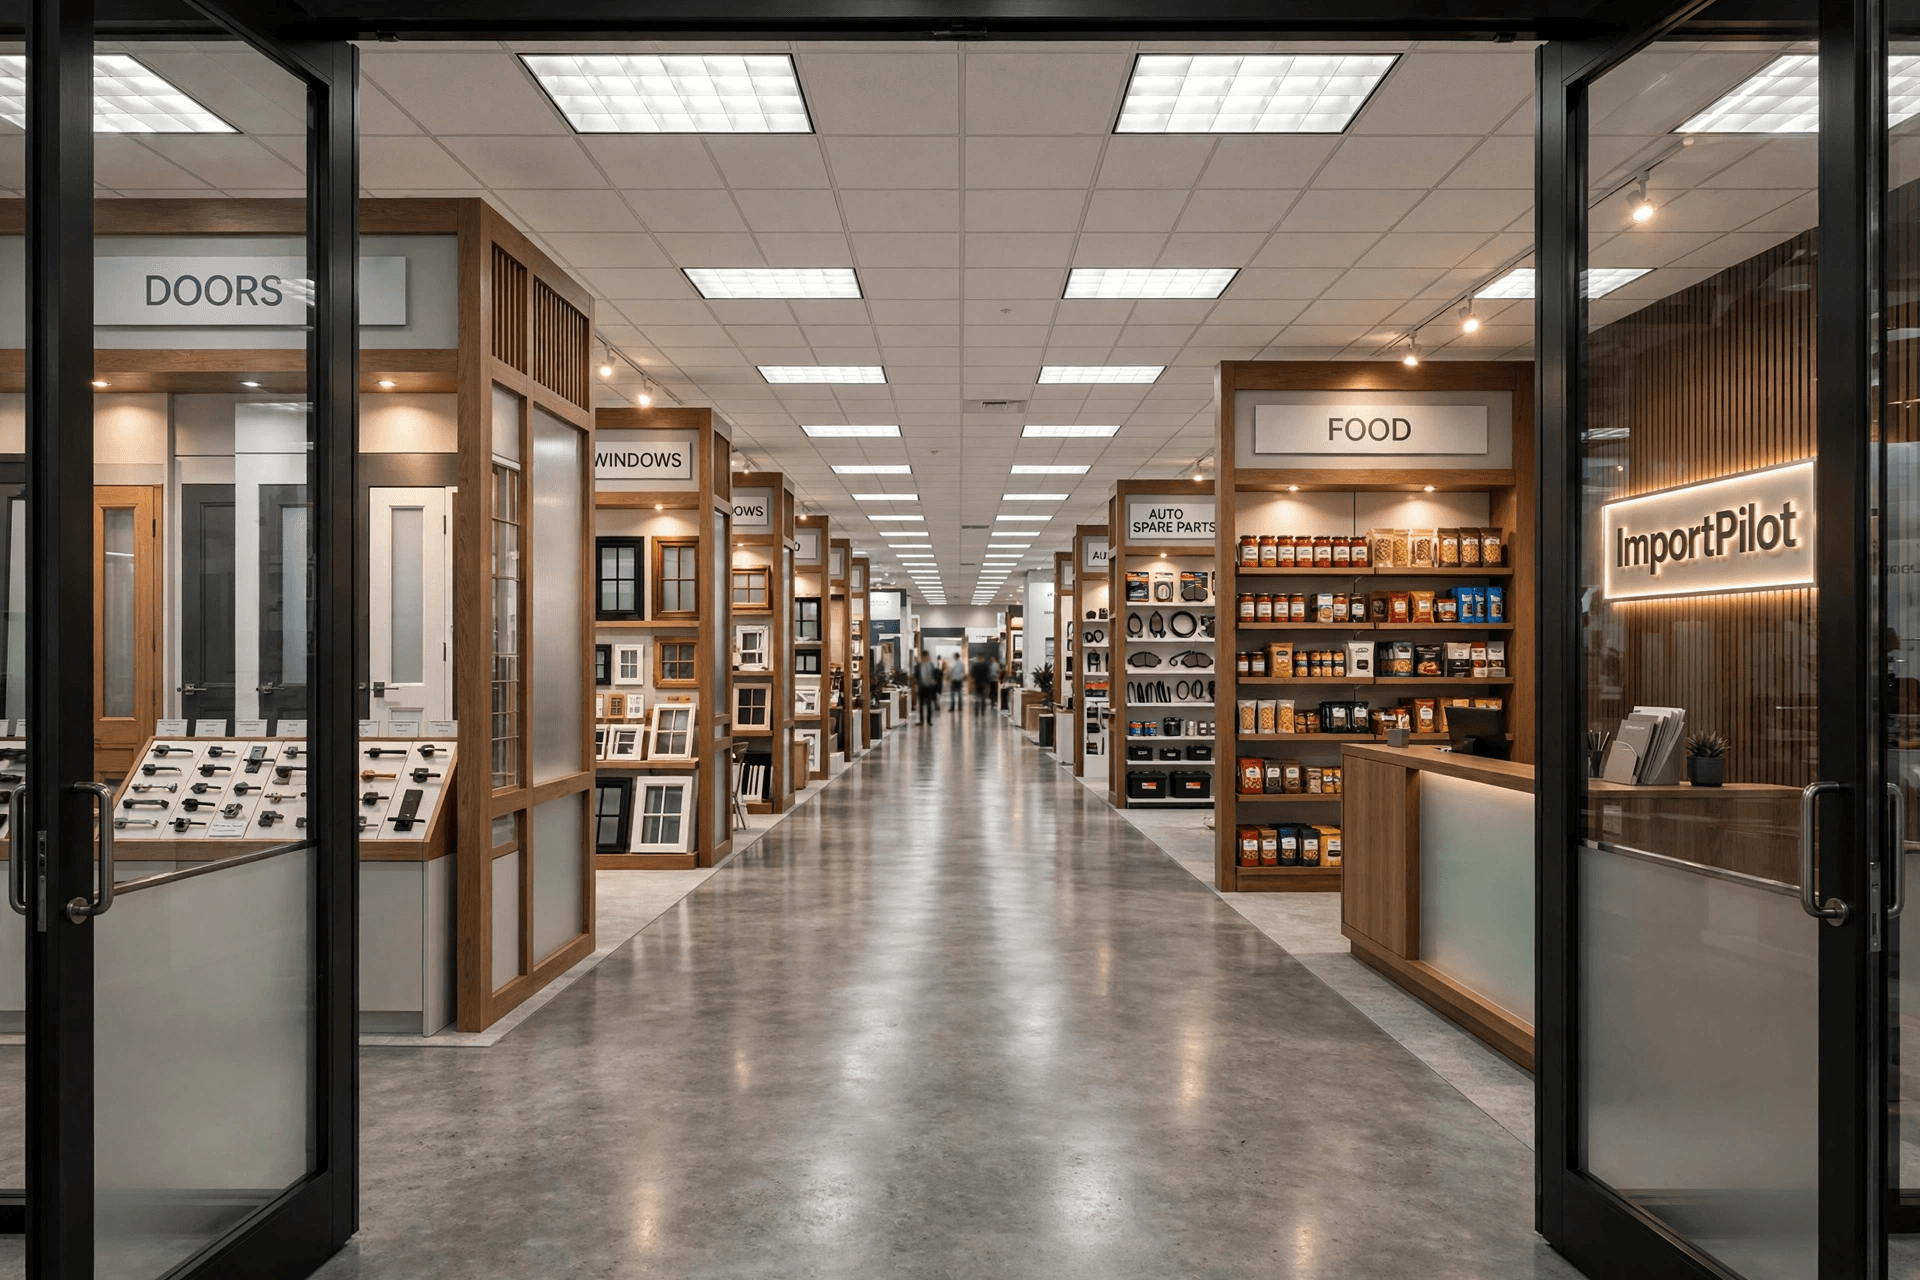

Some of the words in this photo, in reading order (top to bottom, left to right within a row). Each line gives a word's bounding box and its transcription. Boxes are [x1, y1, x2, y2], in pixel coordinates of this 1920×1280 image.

[145, 274, 283, 306] DOORS
[1328, 417, 1412, 442] FOOD
[595, 452, 682, 468] WINDOWS
[1148, 508, 1184, 520] AUTO
[1133, 521, 1173, 533] SPARE
[1177, 521, 1216, 533] PARTS
[1616, 501, 1797, 575] ImportPilot
